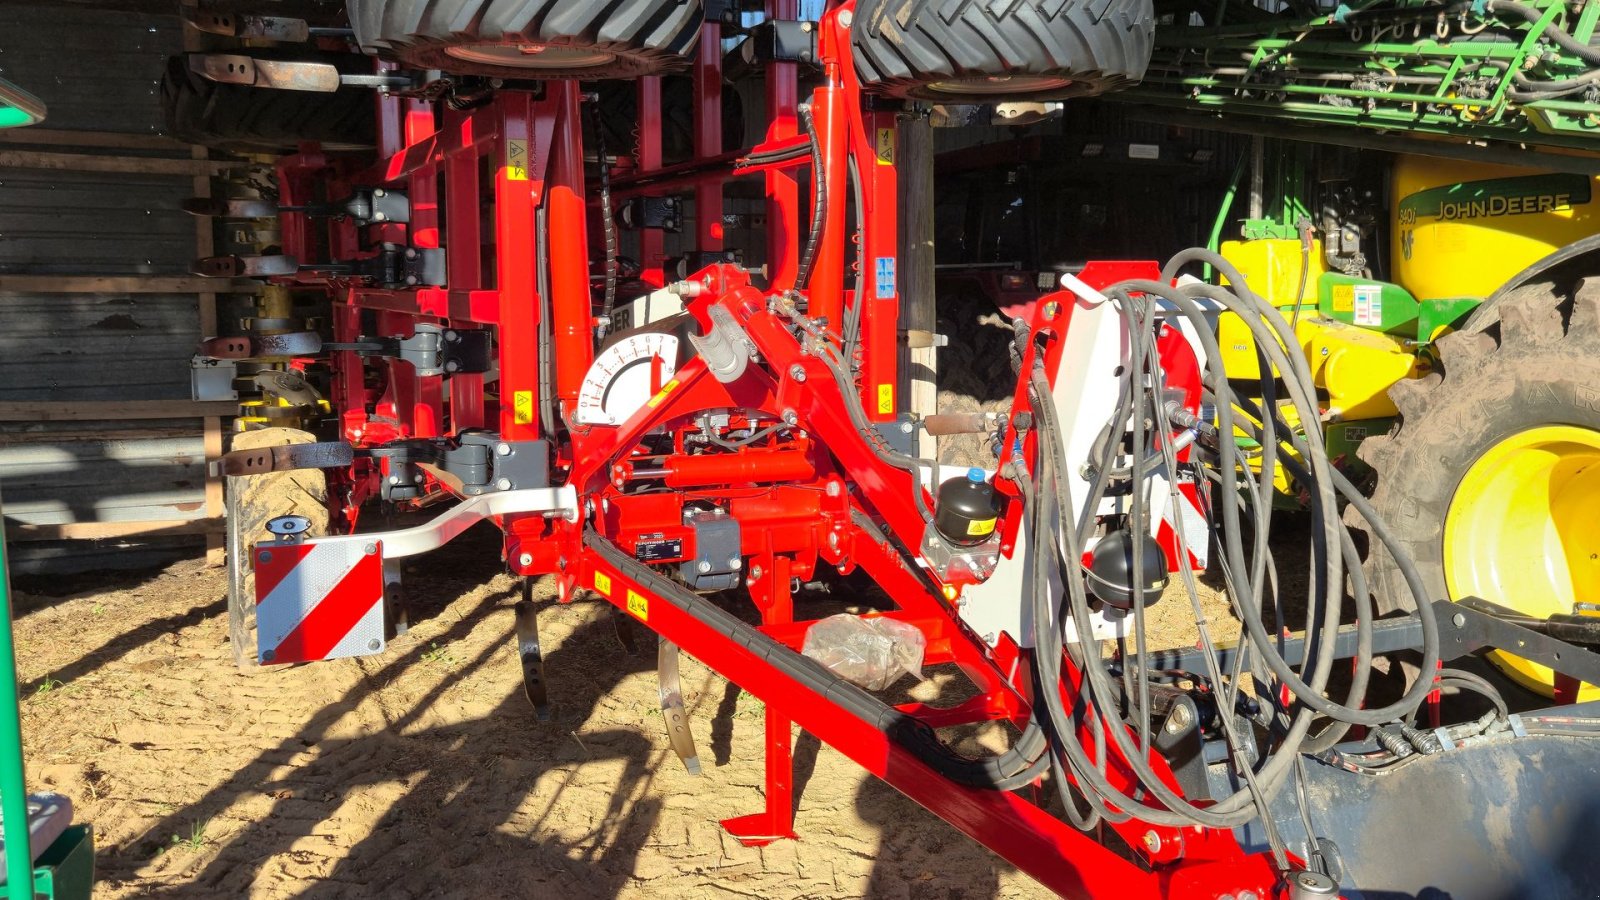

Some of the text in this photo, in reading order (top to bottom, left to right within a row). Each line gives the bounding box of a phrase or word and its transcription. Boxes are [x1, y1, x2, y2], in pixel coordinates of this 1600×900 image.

[1435, 194, 1570, 221] JOHN DEERE
[629, 339, 636, 347] 5
[645, 335, 651, 343] 6
[613, 347, 619, 355] 4
